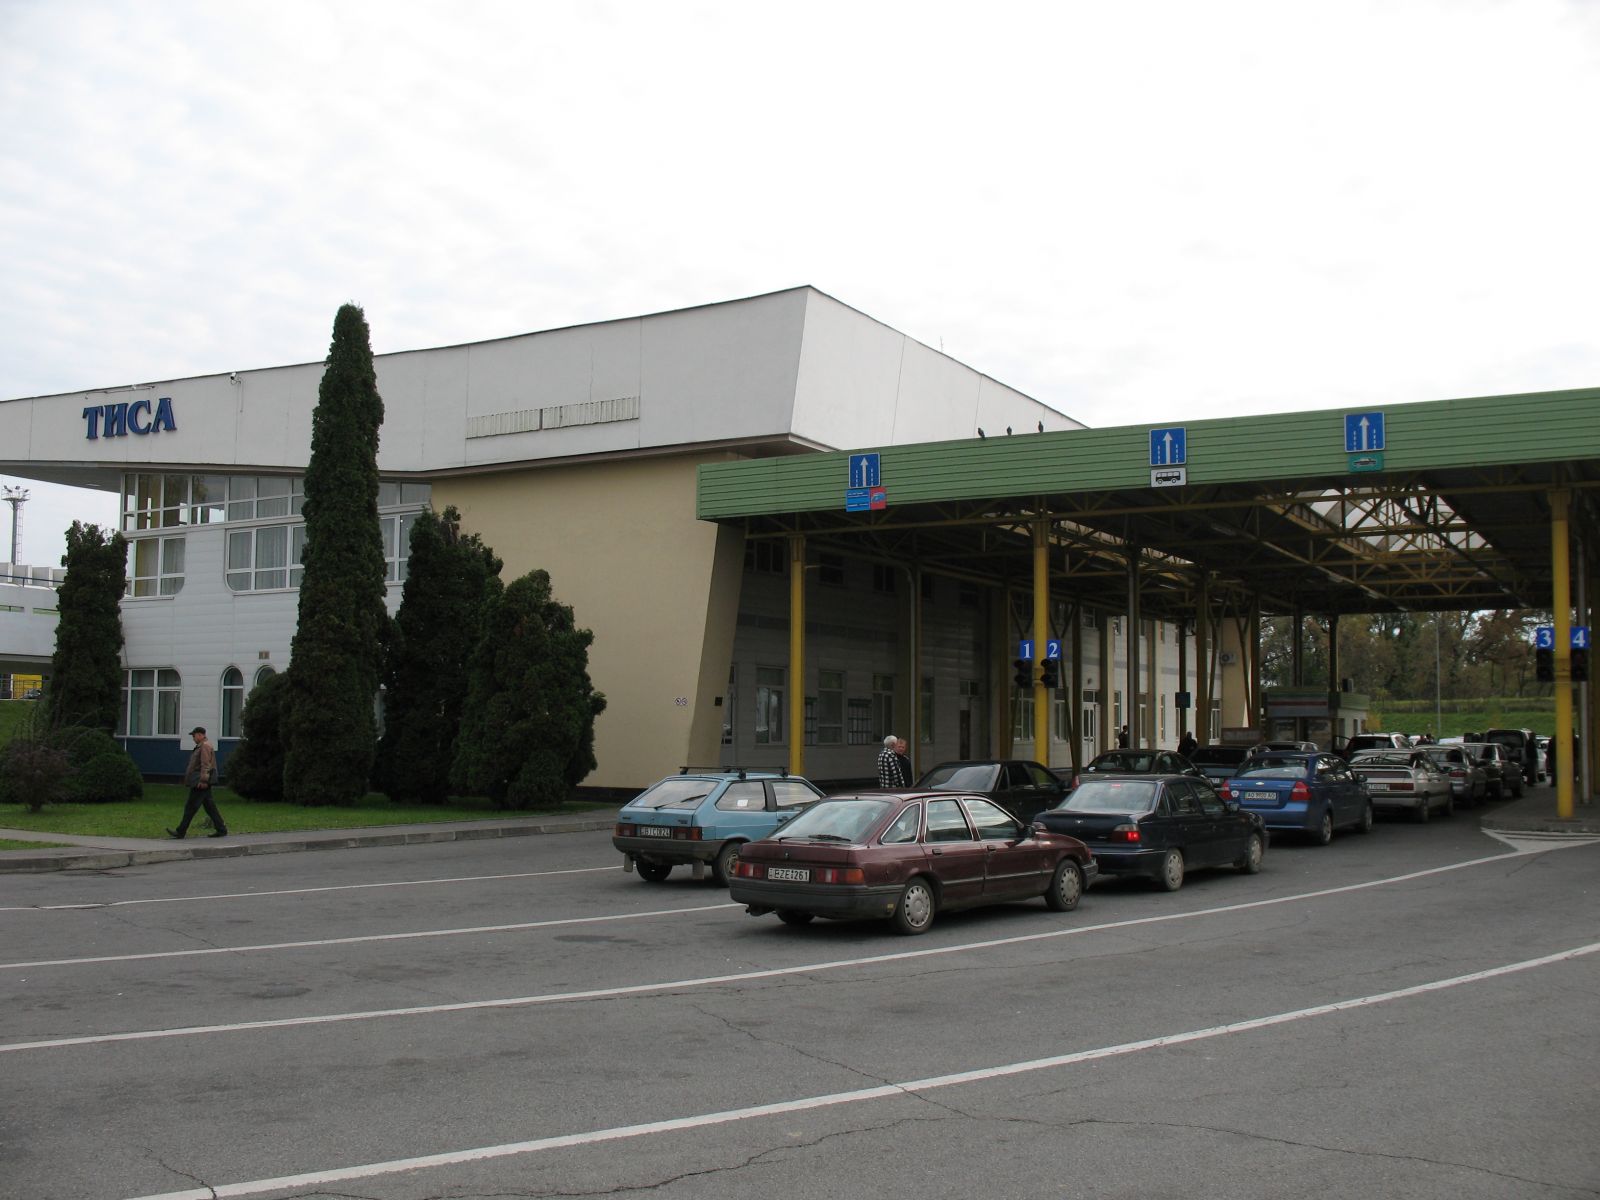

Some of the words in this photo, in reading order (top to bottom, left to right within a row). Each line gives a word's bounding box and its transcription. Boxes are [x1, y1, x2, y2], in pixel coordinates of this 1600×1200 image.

[82, 397, 177, 440] ТИСА
[1540, 630, 1551, 647] 3
[1572, 630, 1585, 647] 4
[1023, 642, 1031, 659] 1
[1049, 642, 1058, 658] 2
